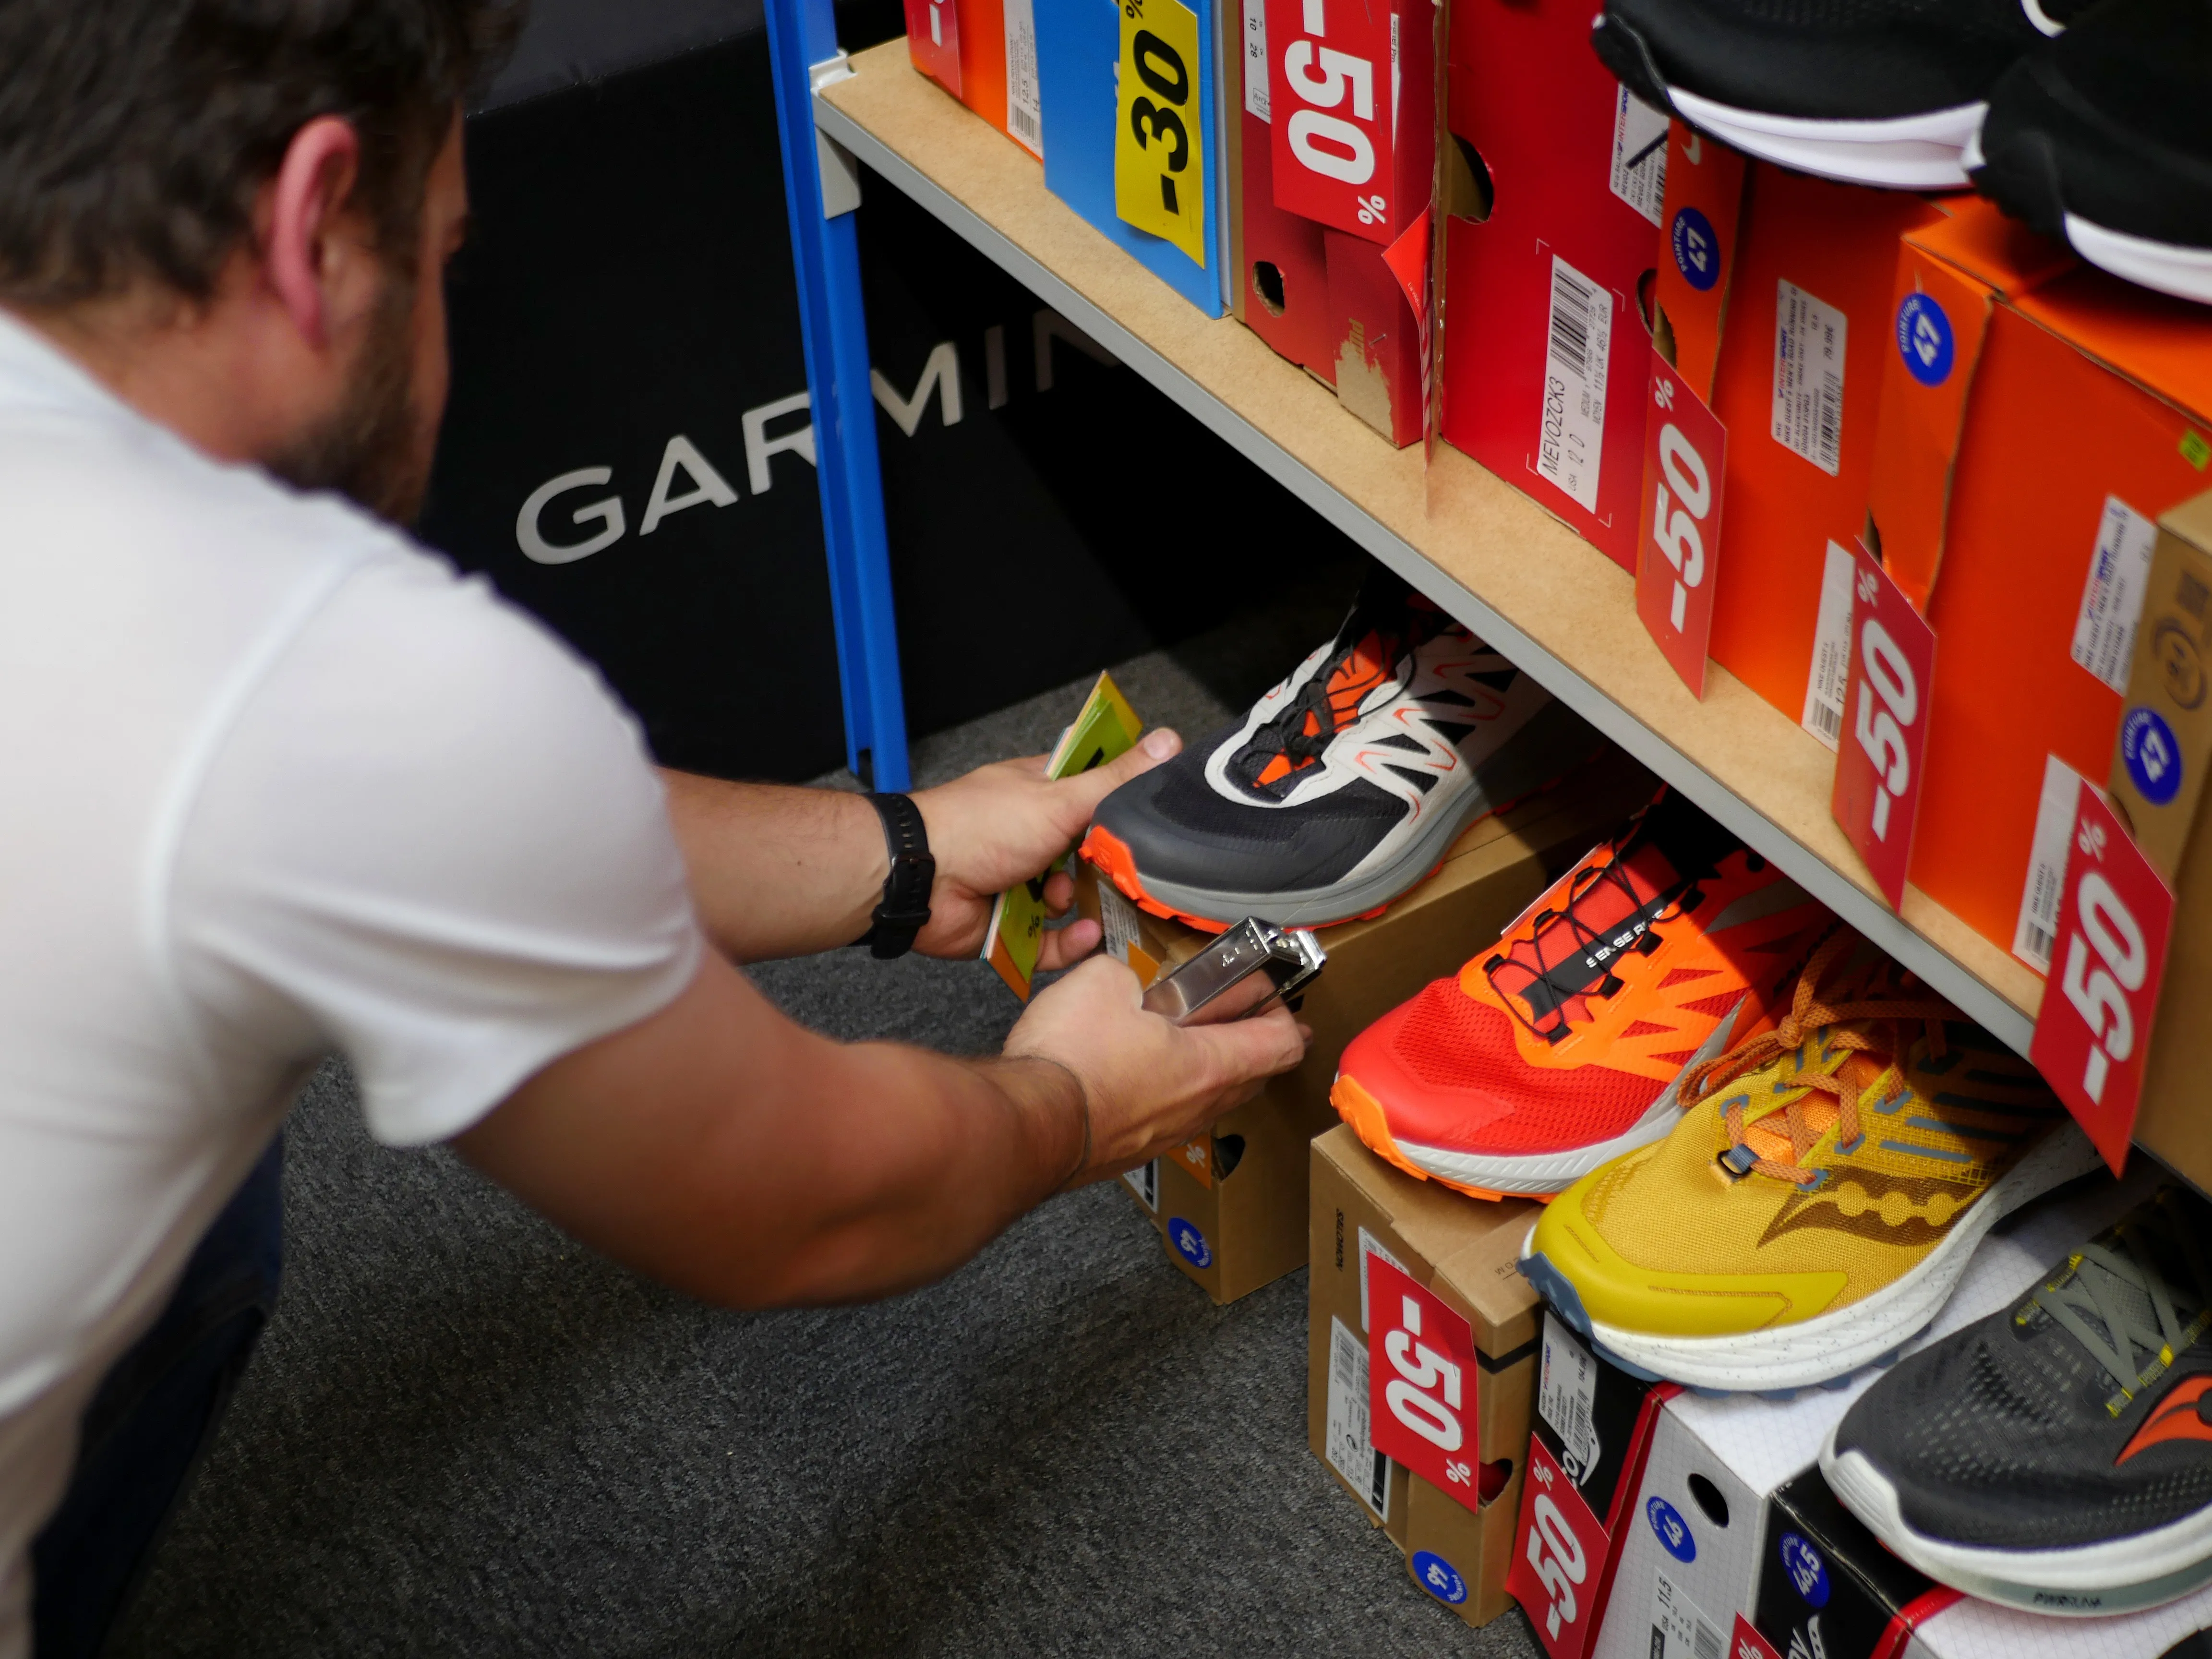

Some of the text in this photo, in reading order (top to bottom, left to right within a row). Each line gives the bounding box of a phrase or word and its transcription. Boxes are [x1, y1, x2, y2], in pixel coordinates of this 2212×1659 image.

[1250, 17, 1257, 31] 10
[1250, 43, 1257, 58] 28
[1131, 30, 1189, 216] -30
[1285, 0, 1386, 225] -50 %
[1686, 226, 1707, 273] 47
[1598, 303, 1608, 325] EUR
[1596, 357, 1604, 370] UK
[1913, 313, 1942, 368] 47
[1542, 376, 1565, 475] MEVOZCK3
[1567, 449, 1584, 467] 12
[1567, 473, 1577, 492] USA
[1653, 379, 1710, 633] -50 %
[1856, 568, 1916, 843] -50 %
[2139, 728, 2171, 784] 47
[2064, 818, 2144, 1107] -50 %
[1385, 1295, 1471, 1489] -50 %
[1533, 1457, 1553, 1491] %
[1662, 1514, 1683, 1549] 46
[1426, 1563, 1449, 1591] 46
[1527, 1494, 1586, 1642] -50
[1657, 1576, 1672, 1609] 11.5
[1792, 1543, 1821, 1597] 46,5
